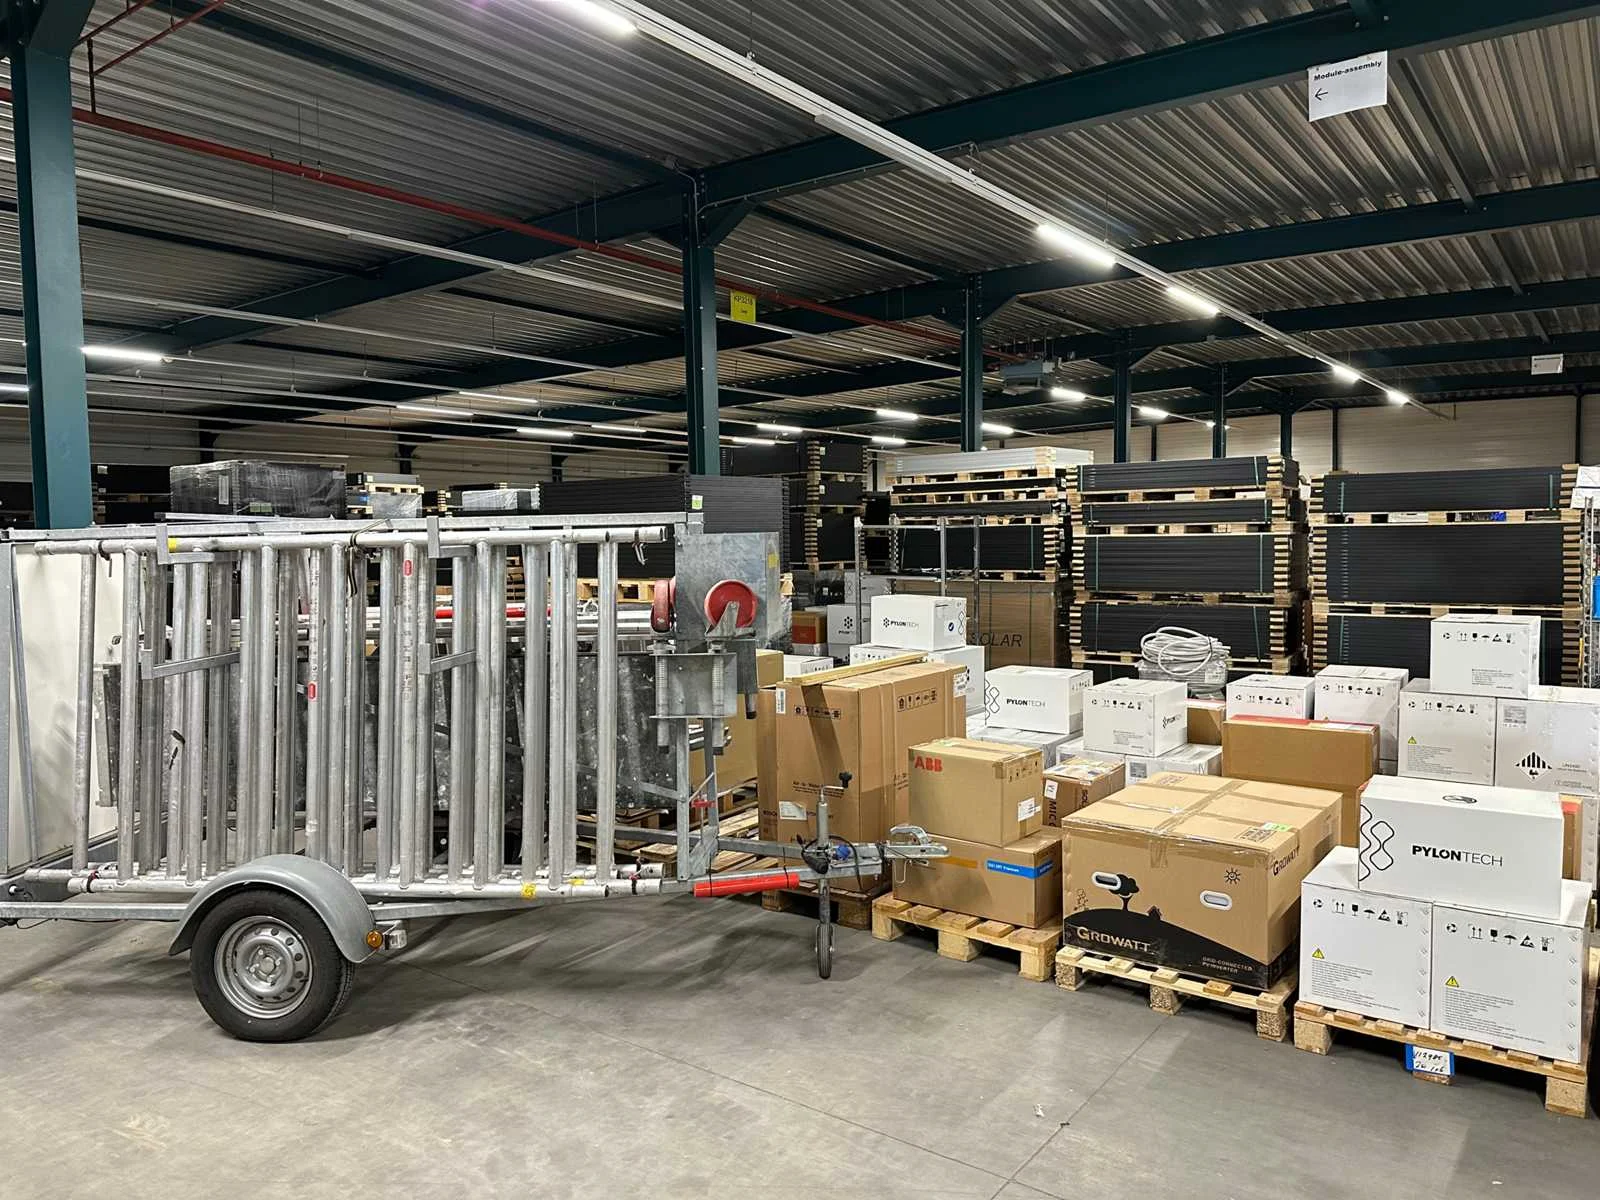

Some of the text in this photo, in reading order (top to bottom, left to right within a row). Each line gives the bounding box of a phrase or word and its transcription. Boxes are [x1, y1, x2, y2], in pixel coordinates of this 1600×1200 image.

[1313, 61, 1382, 81] Module-assembly
[890, 620, 919, 629] PYLONTECH
[970, 633, 1023, 647] SOLAR
[1006, 698, 1046, 708] PYLONTECH
[914, 756, 943, 772] ABB
[1412, 845, 1503, 867] PYLONTECH
[1076, 926, 1151, 952] GROWATT
